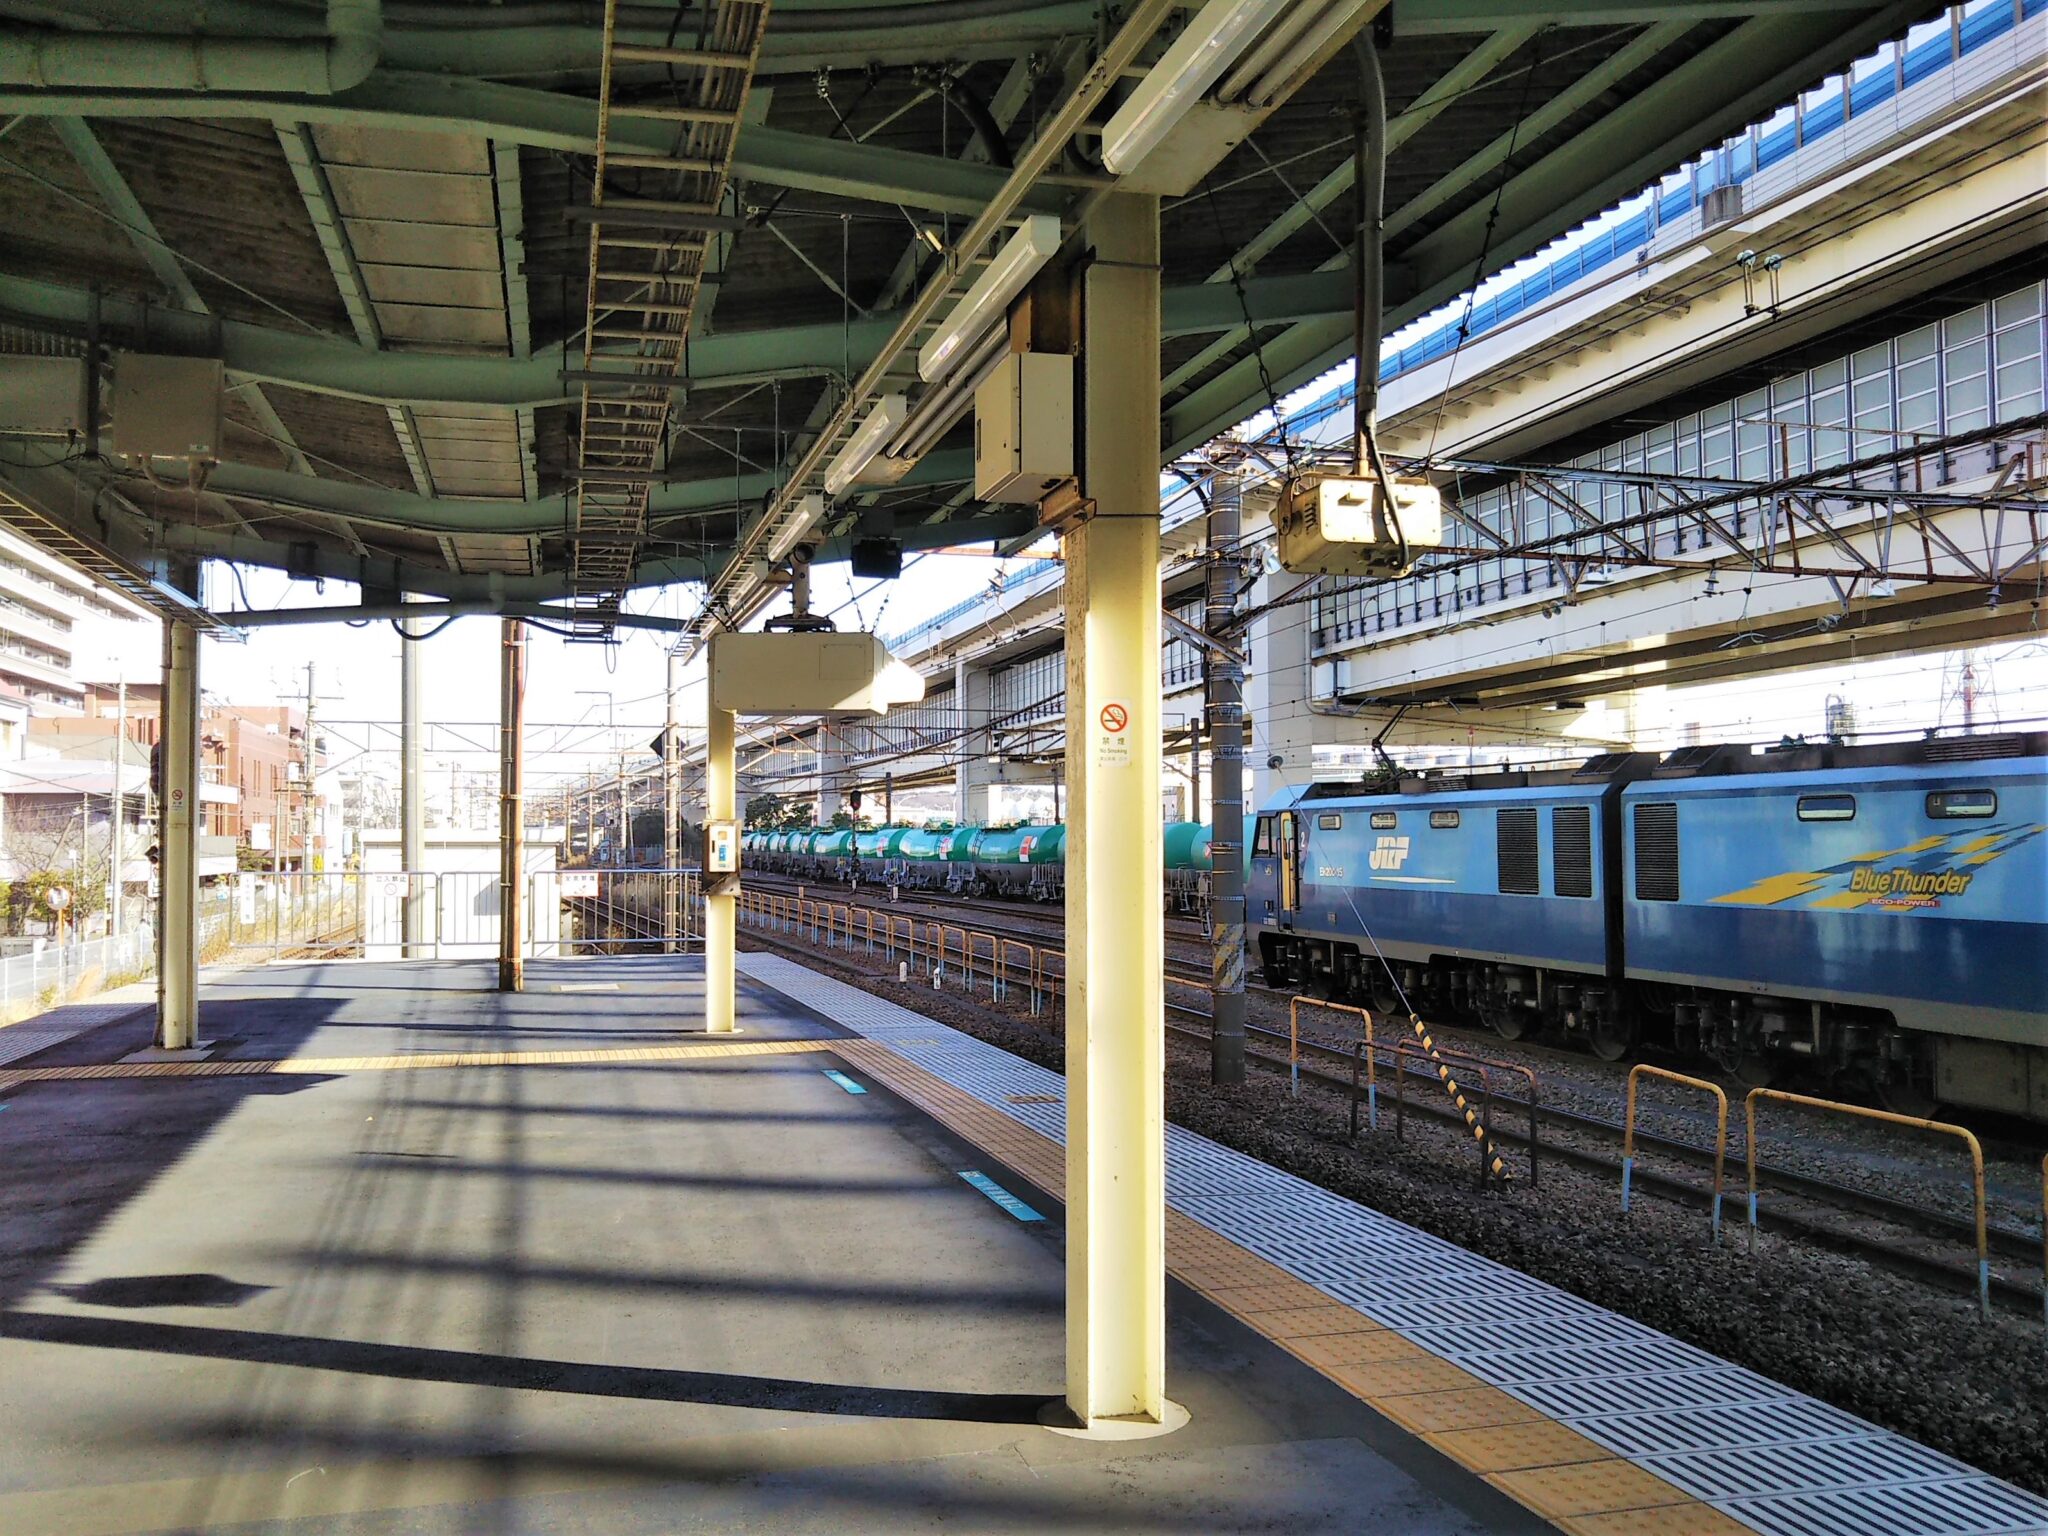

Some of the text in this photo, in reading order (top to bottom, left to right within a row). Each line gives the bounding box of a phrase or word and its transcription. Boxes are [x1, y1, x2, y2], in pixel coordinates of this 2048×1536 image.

[1300, 831, 1306, 848] 2
[1369, 836, 1410, 870] JRF
[1871, 898, 1936, 907] ECO-POWER
